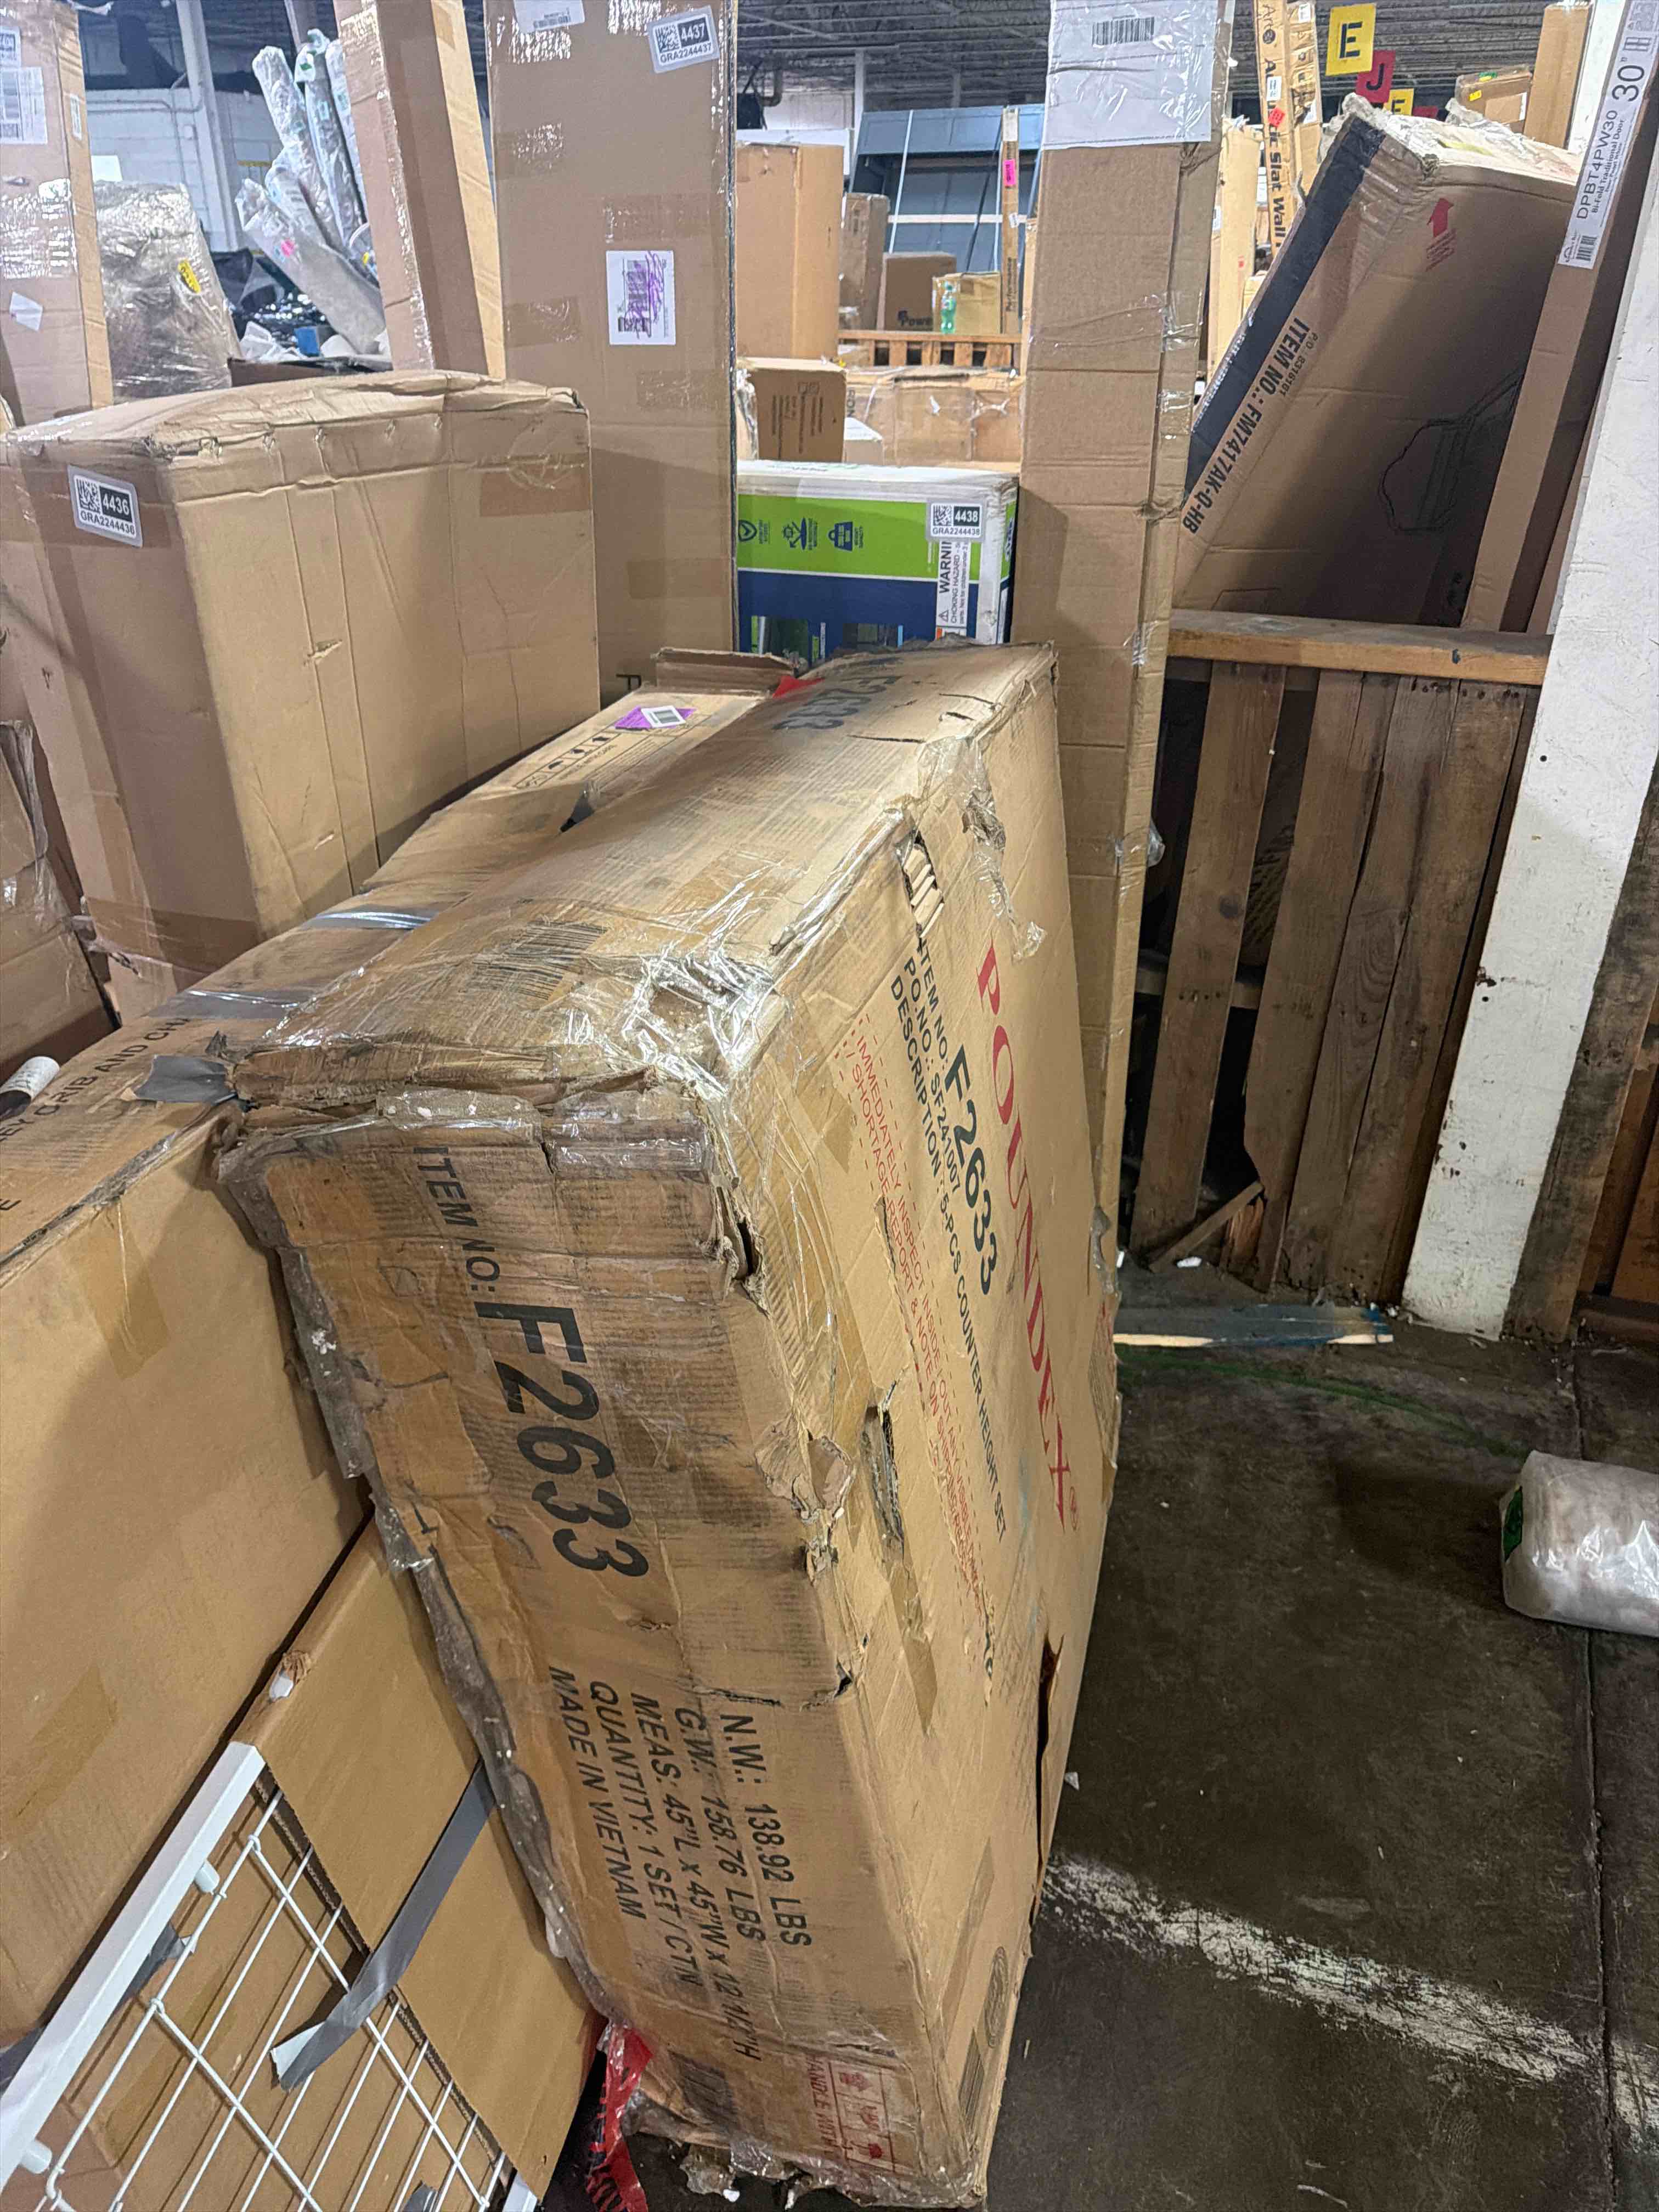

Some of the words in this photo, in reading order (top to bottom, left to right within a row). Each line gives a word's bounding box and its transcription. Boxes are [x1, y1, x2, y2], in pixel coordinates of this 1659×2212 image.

[660, 43, 712, 64] GRA2244437
[680, 24, 706, 43] 4437
[1339, 21, 1363, 58] E
[1366, 63, 1385, 91] J
[1270, 152, 1283, 193] Slat
[1576, 110, 1618, 220] DPBT4PW30
[1592, 185, 1605, 213] Bi-Fold
[1600, 142, 1618, 183] Traditional
[1613, 119, 1624, 139] Door
[1273, 197, 1286, 238] Wall
[1274, 317, 1310, 369] ITEM
[80, 510, 136, 536] GRA2244436
[103, 492, 130, 517] 4436
[932, 527, 980, 536] GRA2244438
[955, 510, 979, 522] 4438
[951, 588, 959, 624] CHOKING
[0, 1118, 35, 1142] EY
[34, 1075, 98, 1116] CRIB
[94, 1044, 149, 1073] AND
[930, 1072, 961, 1193] SF241007
[413, 1146, 479, 1228] ITEM
[857, 1035, 901, 1190] IMMEDIATELY
[898, 1195, 926, 1291] INSPECT
[945, 1044, 997, 1295] F2633
[976, 933, 1071, 1534] POUNDEX
[460, 1237, 500, 1294] NO:
[911, 1297, 917, 1317] &
[916, 1316, 933, 1381] NOTE
[929, 1380, 939, 1417] ON
[957, 1274, 983, 1404] COUNTER
[978, 1400, 998, 1494] HEIGHT
[994, 1491, 1006, 1543] SET
[473, 1301, 650, 1578] F2633
[549, 1665, 598, 1757] MADE
[630, 1691, 682, 1787] MEAS:
[575, 1761, 609, 1793] IN
[589, 1680, 657, 1838] QUANTITY:
[588, 1799, 647, 1921] VIETNAM
[637, 1843, 665, 1859] 1
[700, 1794, 748, 1879] 158.76
[725, 1887, 766, 1943] LBS
[744, 1803, 795, 1883] 138.92
[642, 1861, 681, 1920] SET
[769, 1895, 812, 1949] LBS
[664, 1934, 704, 1987] CTN
